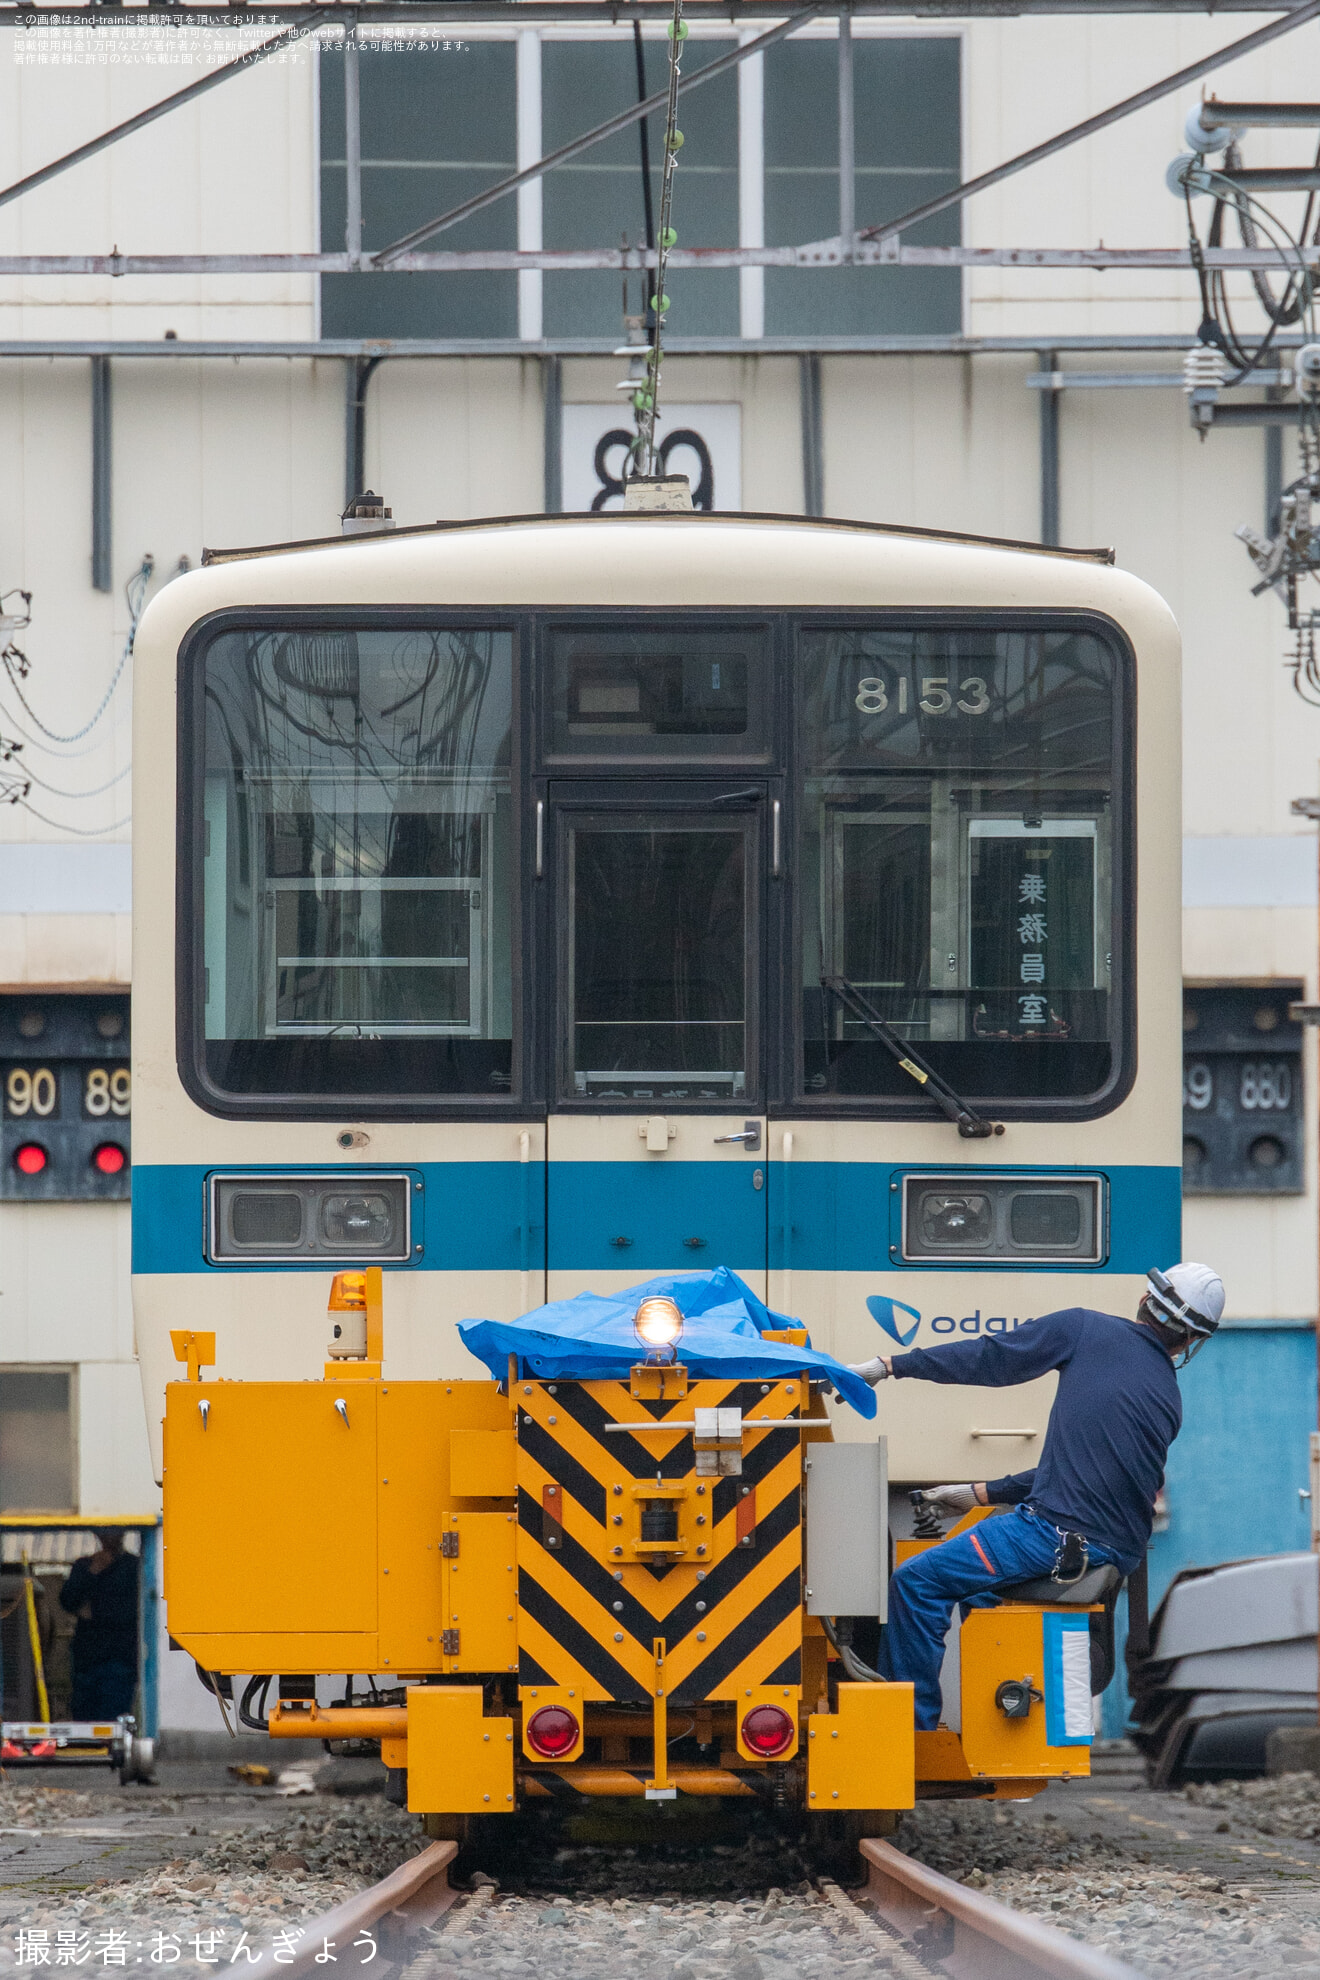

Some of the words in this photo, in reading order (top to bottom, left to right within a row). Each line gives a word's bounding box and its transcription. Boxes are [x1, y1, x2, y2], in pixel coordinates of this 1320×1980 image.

[855, 677, 991, 715] 8153
[7, 1067, 56, 1116] 90
[85, 1067, 131, 1116] 89
[1182, 1062, 1213, 1110] 9
